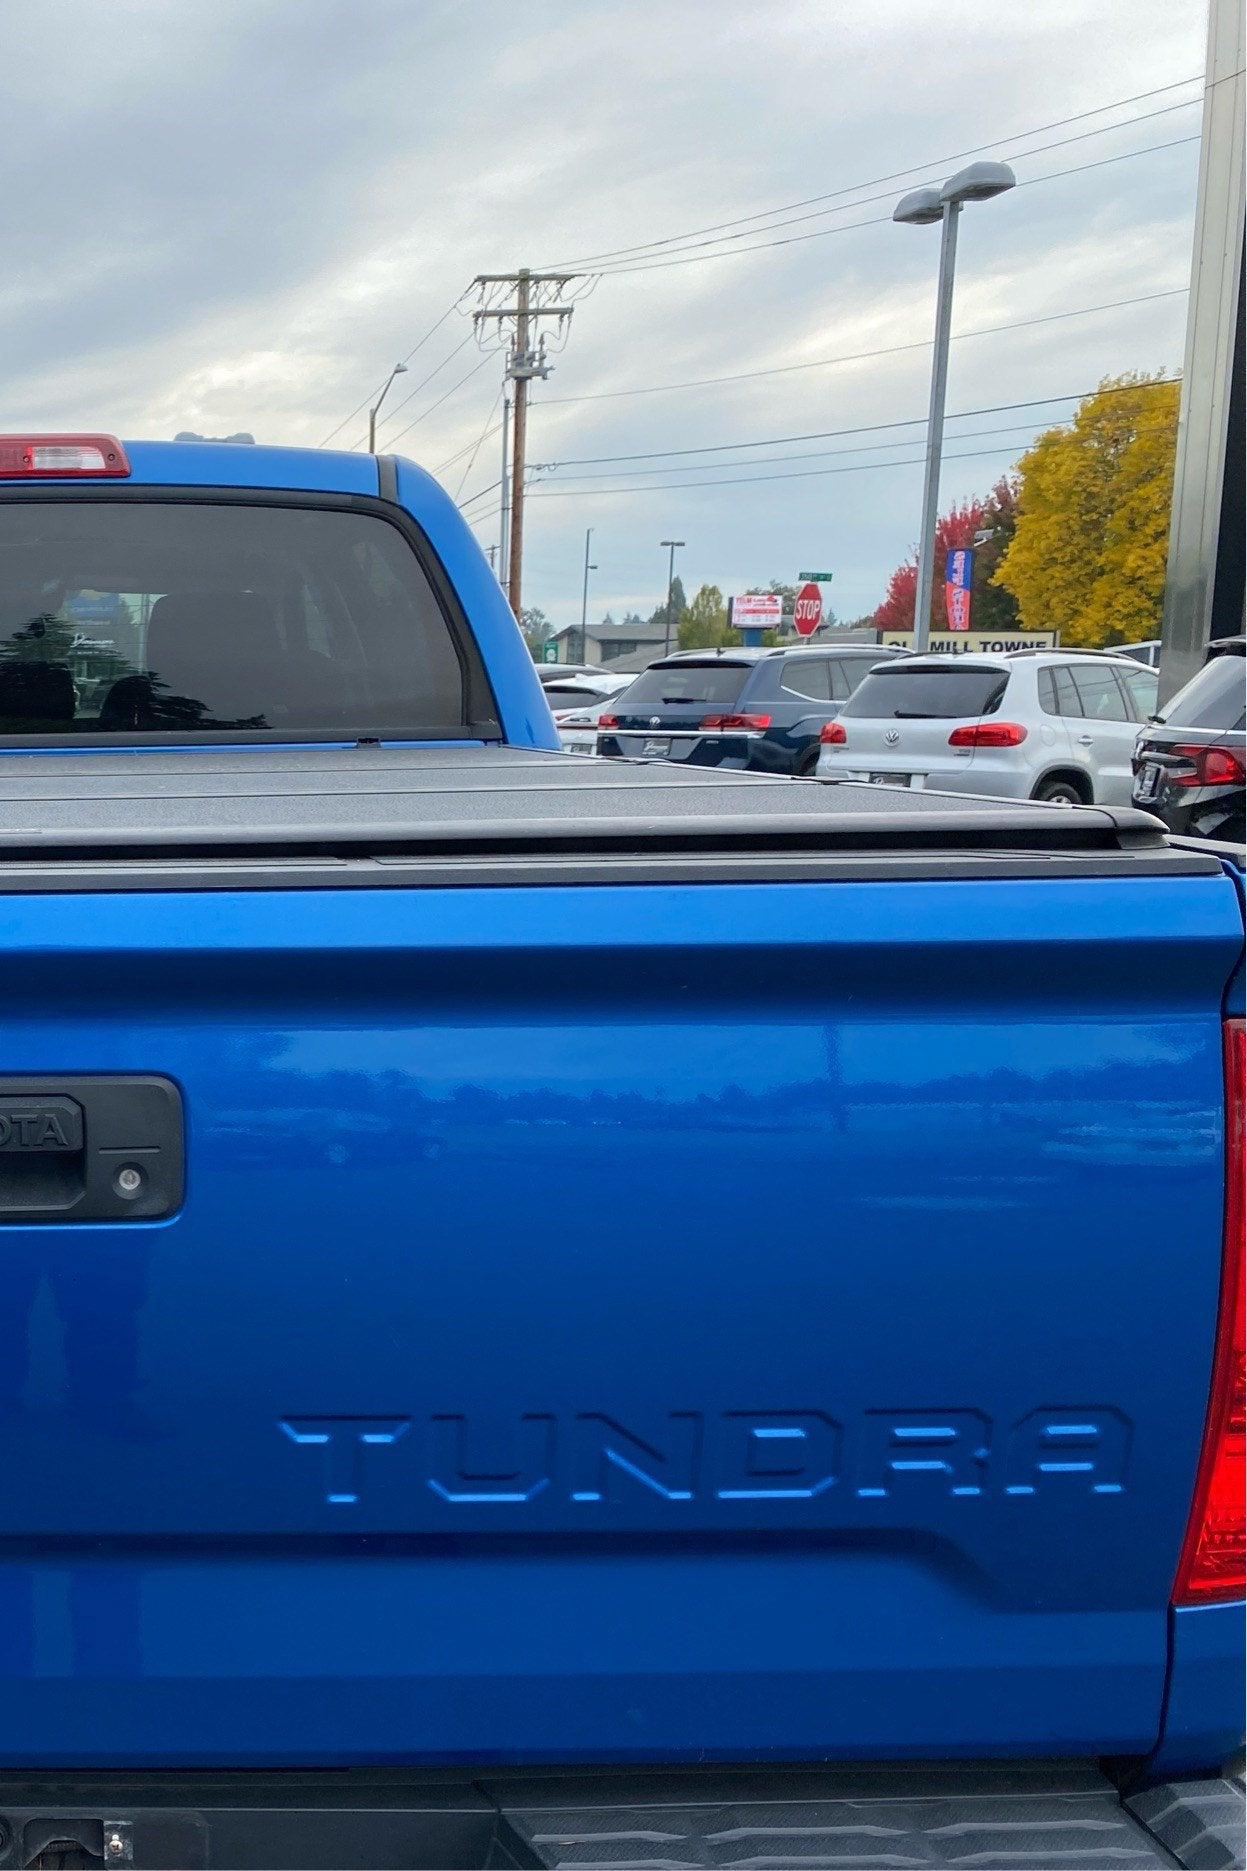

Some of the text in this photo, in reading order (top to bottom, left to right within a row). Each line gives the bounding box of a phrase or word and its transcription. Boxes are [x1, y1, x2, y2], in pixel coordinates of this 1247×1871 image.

[795, 599, 821, 620] STOP
[930, 641, 973, 653] MILL
[979, 641, 1047, 653] TOWNE
[277, 1405, 1136, 1503] TUNDRA
